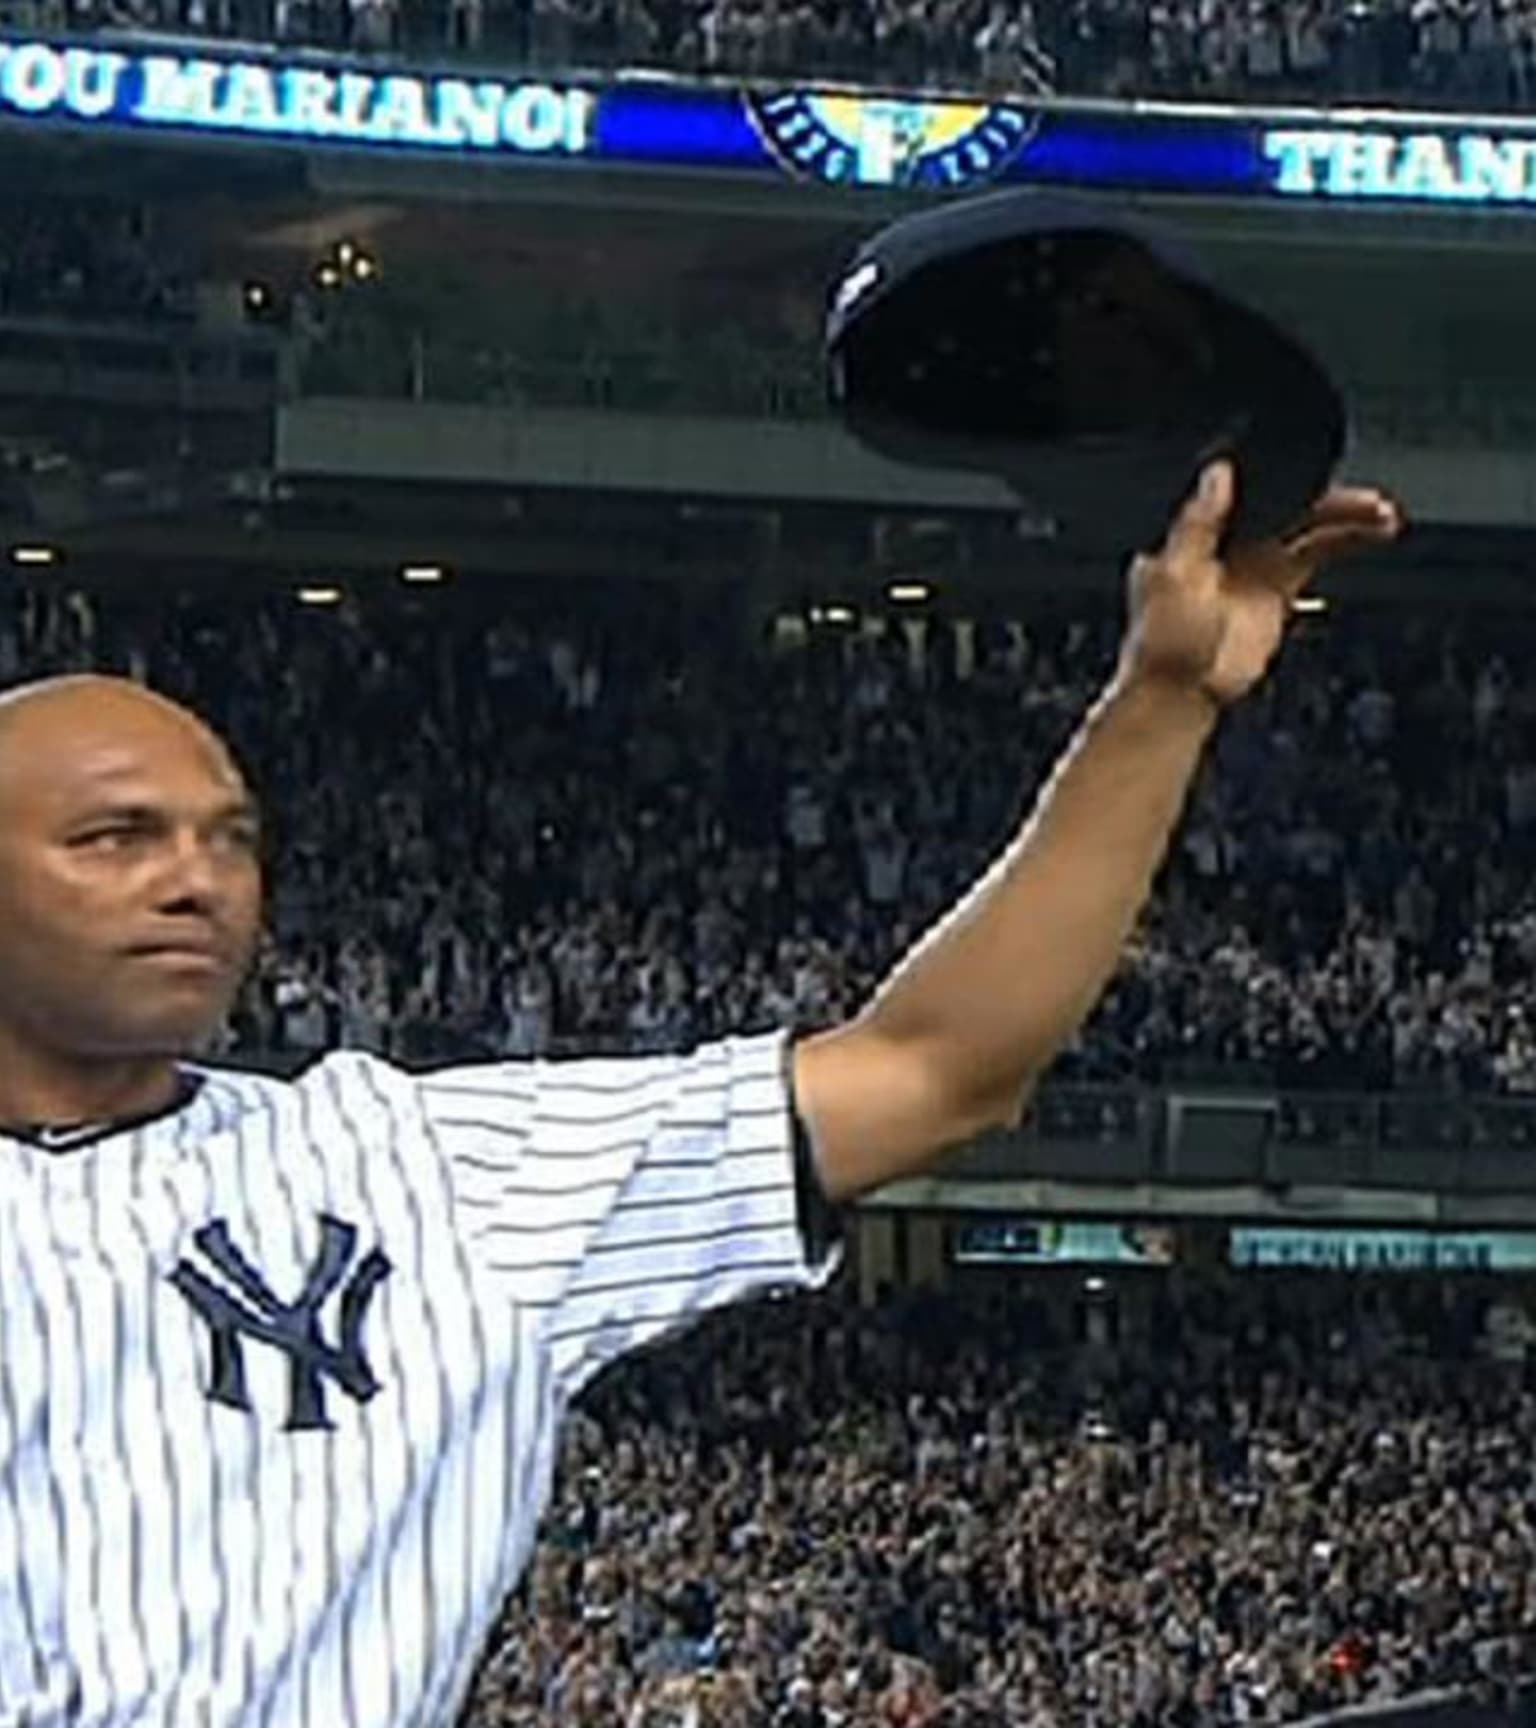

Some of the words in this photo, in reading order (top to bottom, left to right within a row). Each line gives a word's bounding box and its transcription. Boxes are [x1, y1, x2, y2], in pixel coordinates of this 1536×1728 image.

[130, 56, 592, 151] MARIANO!
[1264, 131, 1536, 200] THAN
[165, 1210, 395, 1433] NY
